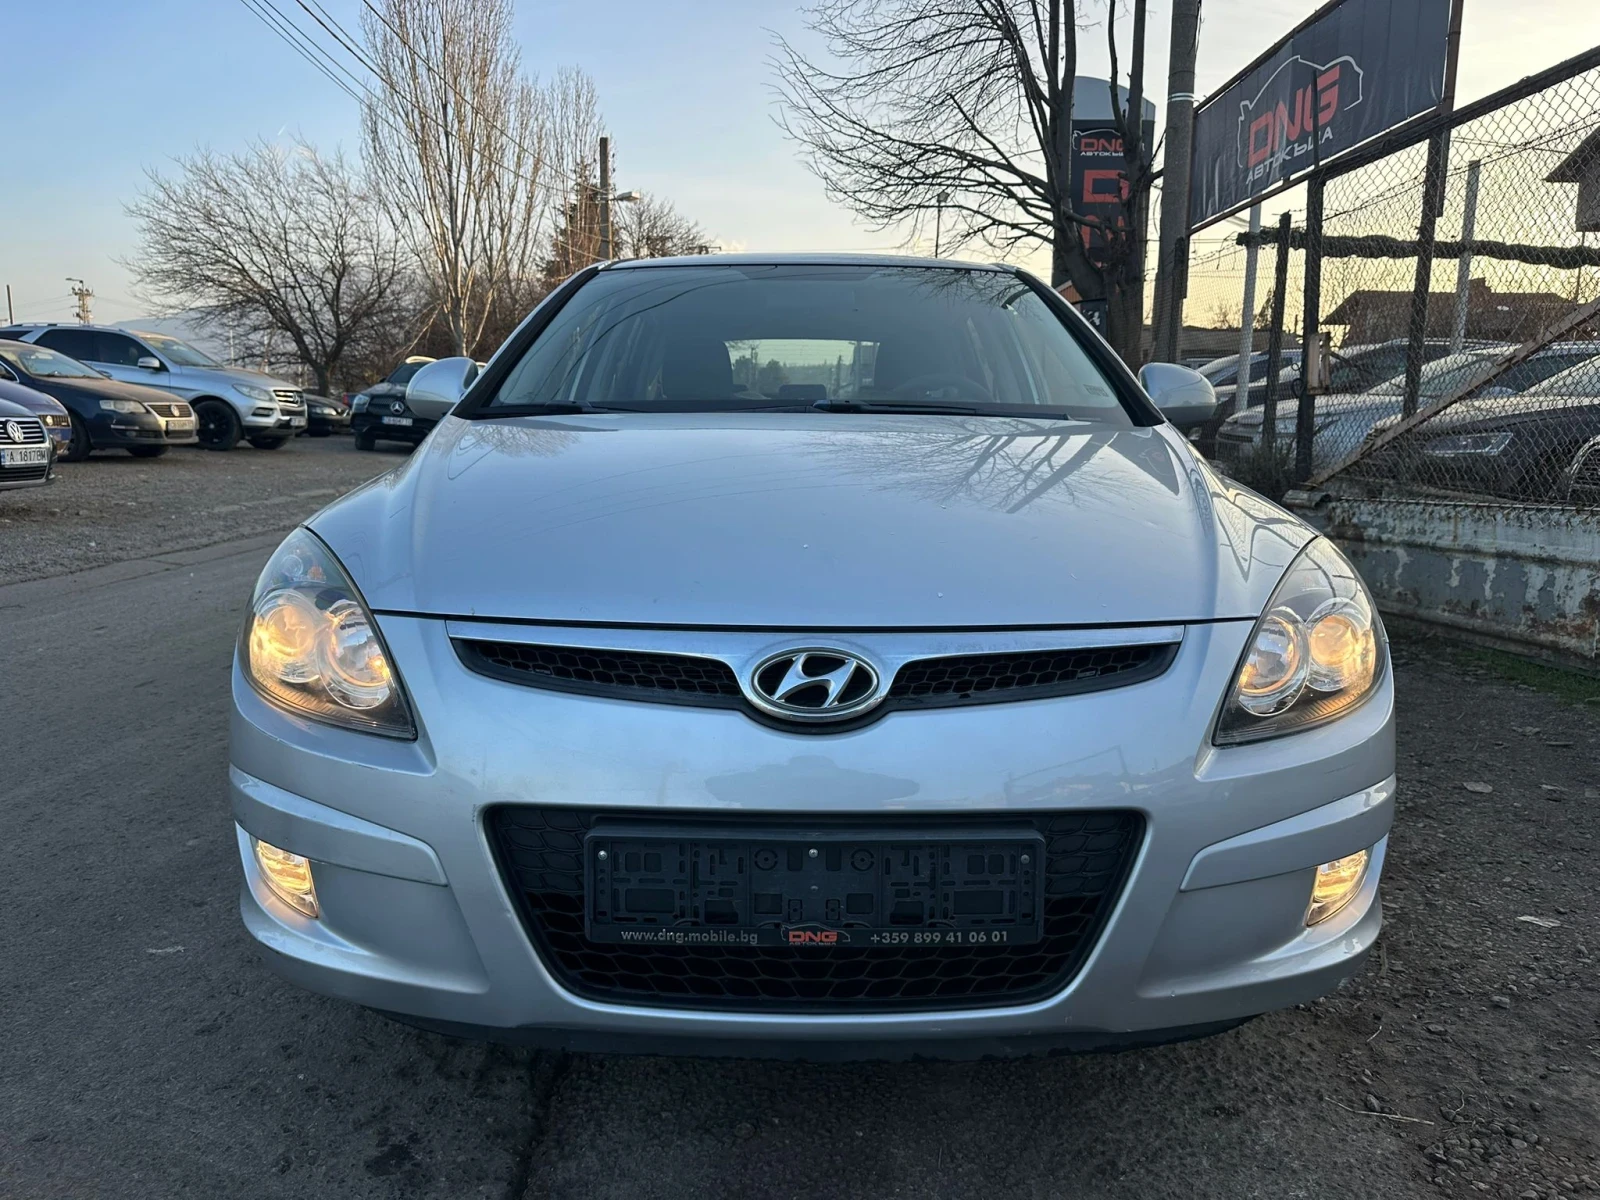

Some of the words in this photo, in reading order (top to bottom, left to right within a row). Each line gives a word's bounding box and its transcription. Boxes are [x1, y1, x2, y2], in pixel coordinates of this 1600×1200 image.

[1247, 65, 1340, 169] DNG
[621, 928, 758, 944] www.dng.mobile.bg
[788, 931, 838, 942] DNG
[870, 932, 909, 944] +359
[914, 932, 941, 944] 899
[946, 932, 962, 943] 41
[969, 931, 987, 943] 06
[991, 931, 1007, 942] 01
